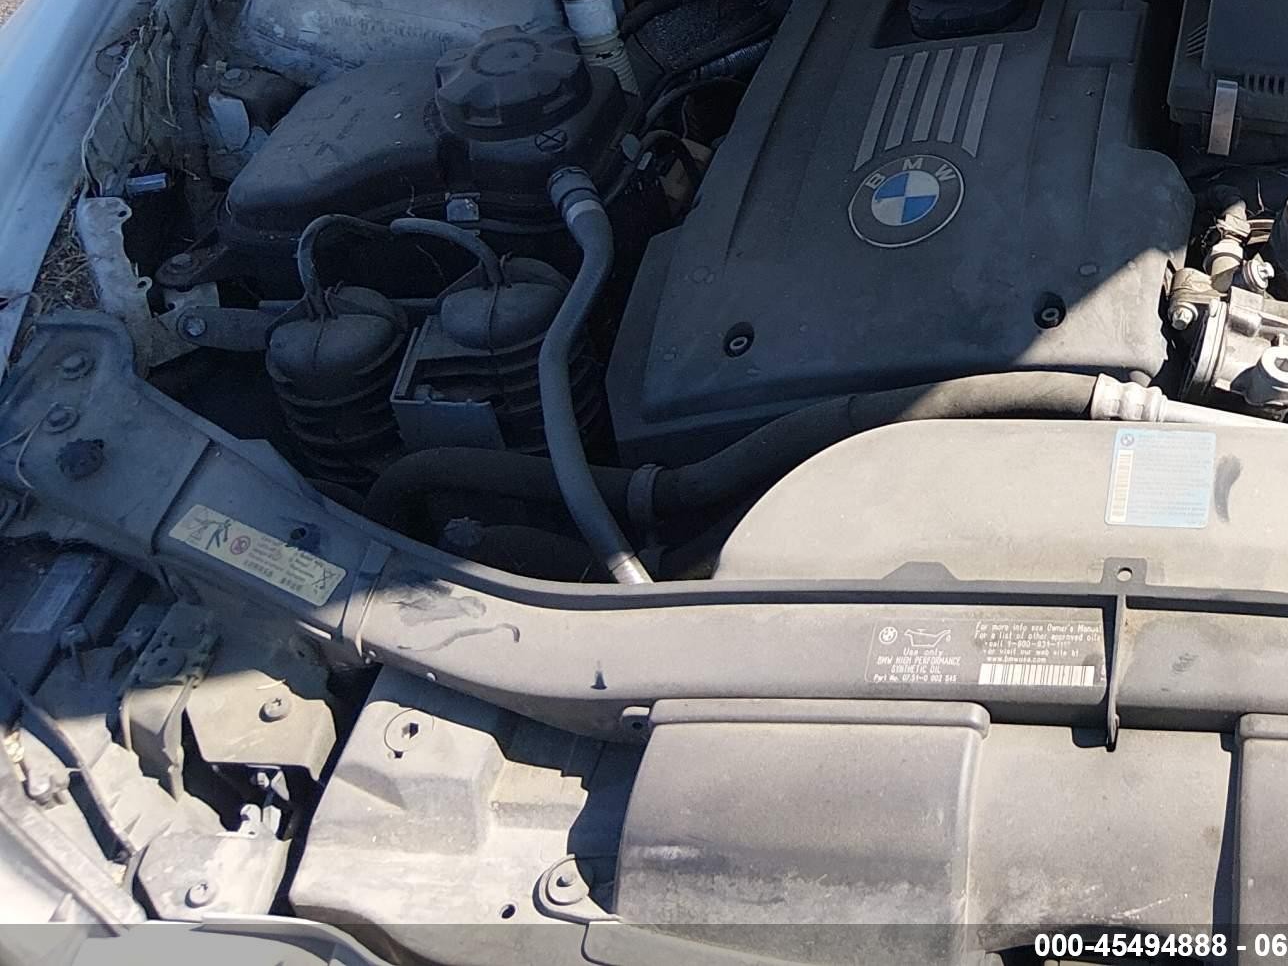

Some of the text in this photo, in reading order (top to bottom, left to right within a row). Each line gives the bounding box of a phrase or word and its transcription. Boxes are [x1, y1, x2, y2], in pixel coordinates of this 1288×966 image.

[865, 158, 957, 190] BMW
[975, 621, 988, 631] For
[1012, 623, 1028, 632] info
[1047, 623, 1075, 634] Owner's
[1077, 624, 1102, 634] Manual
[974, 630, 988, 639] For
[1000, 631, 1013, 640] list
[1016, 631, 1026, 640] of
[1028, 632, 1048, 640] other
[1051, 633, 1083, 642] approved
[1086, 634, 1101, 642] oils
[988, 640, 1003, 648] call
[903, 647, 944, 657] Use only
[999, 648, 1017, 656] visit
[877, 656, 961, 666] BMW HIGH PERFORMANCE
[891, 665, 942, 674] SYNTHETIC OIL
[873, 674, 888, 683] Part
